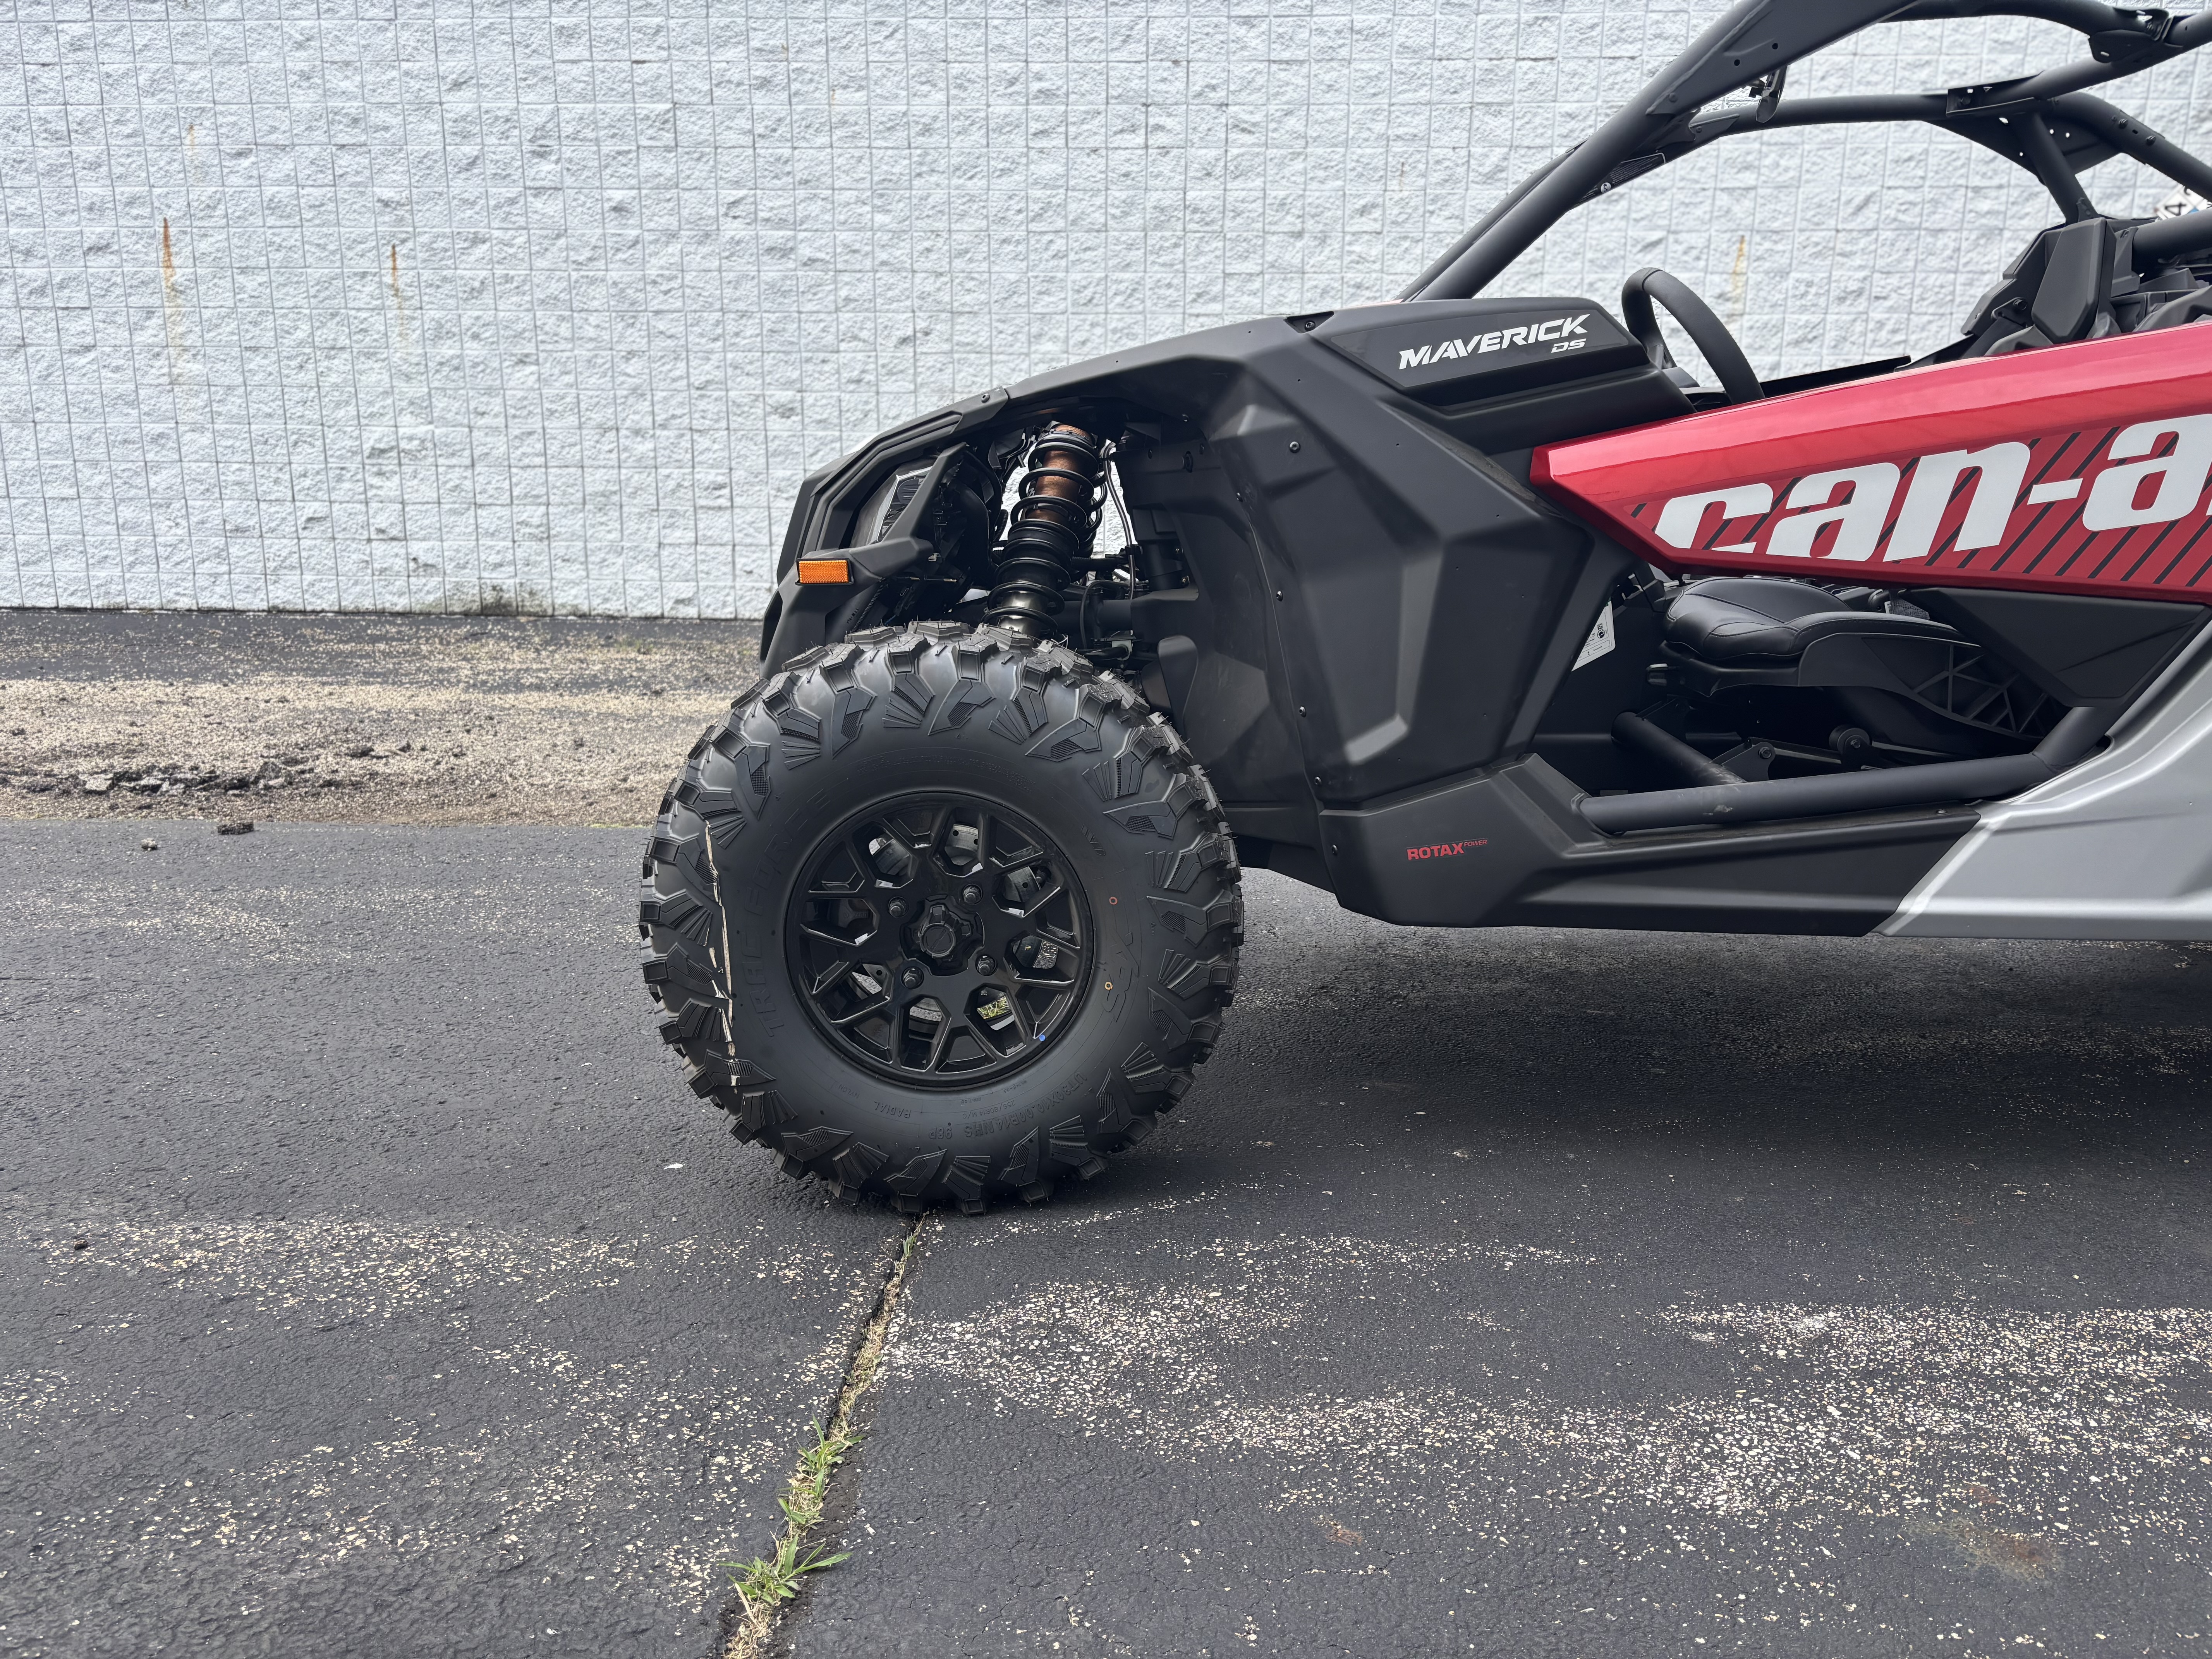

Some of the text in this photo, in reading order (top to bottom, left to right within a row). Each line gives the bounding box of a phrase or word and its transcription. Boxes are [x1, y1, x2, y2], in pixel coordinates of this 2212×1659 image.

[1399, 314, 1590, 369] MAVERICK
[1551, 338, 1587, 353] DS
[1654, 414, 2212, 562] can-a
[1407, 842, 1465, 860] ROTAX
[741, 788, 830, 1037] TRAC FORCE
[838, 1084, 860, 1099] NYLON
[874, 1101, 911, 1119] RADIAL
[962, 1099, 1016, 1119] 255/80R14 M/C
[927, 1126, 953, 1139] 98P
